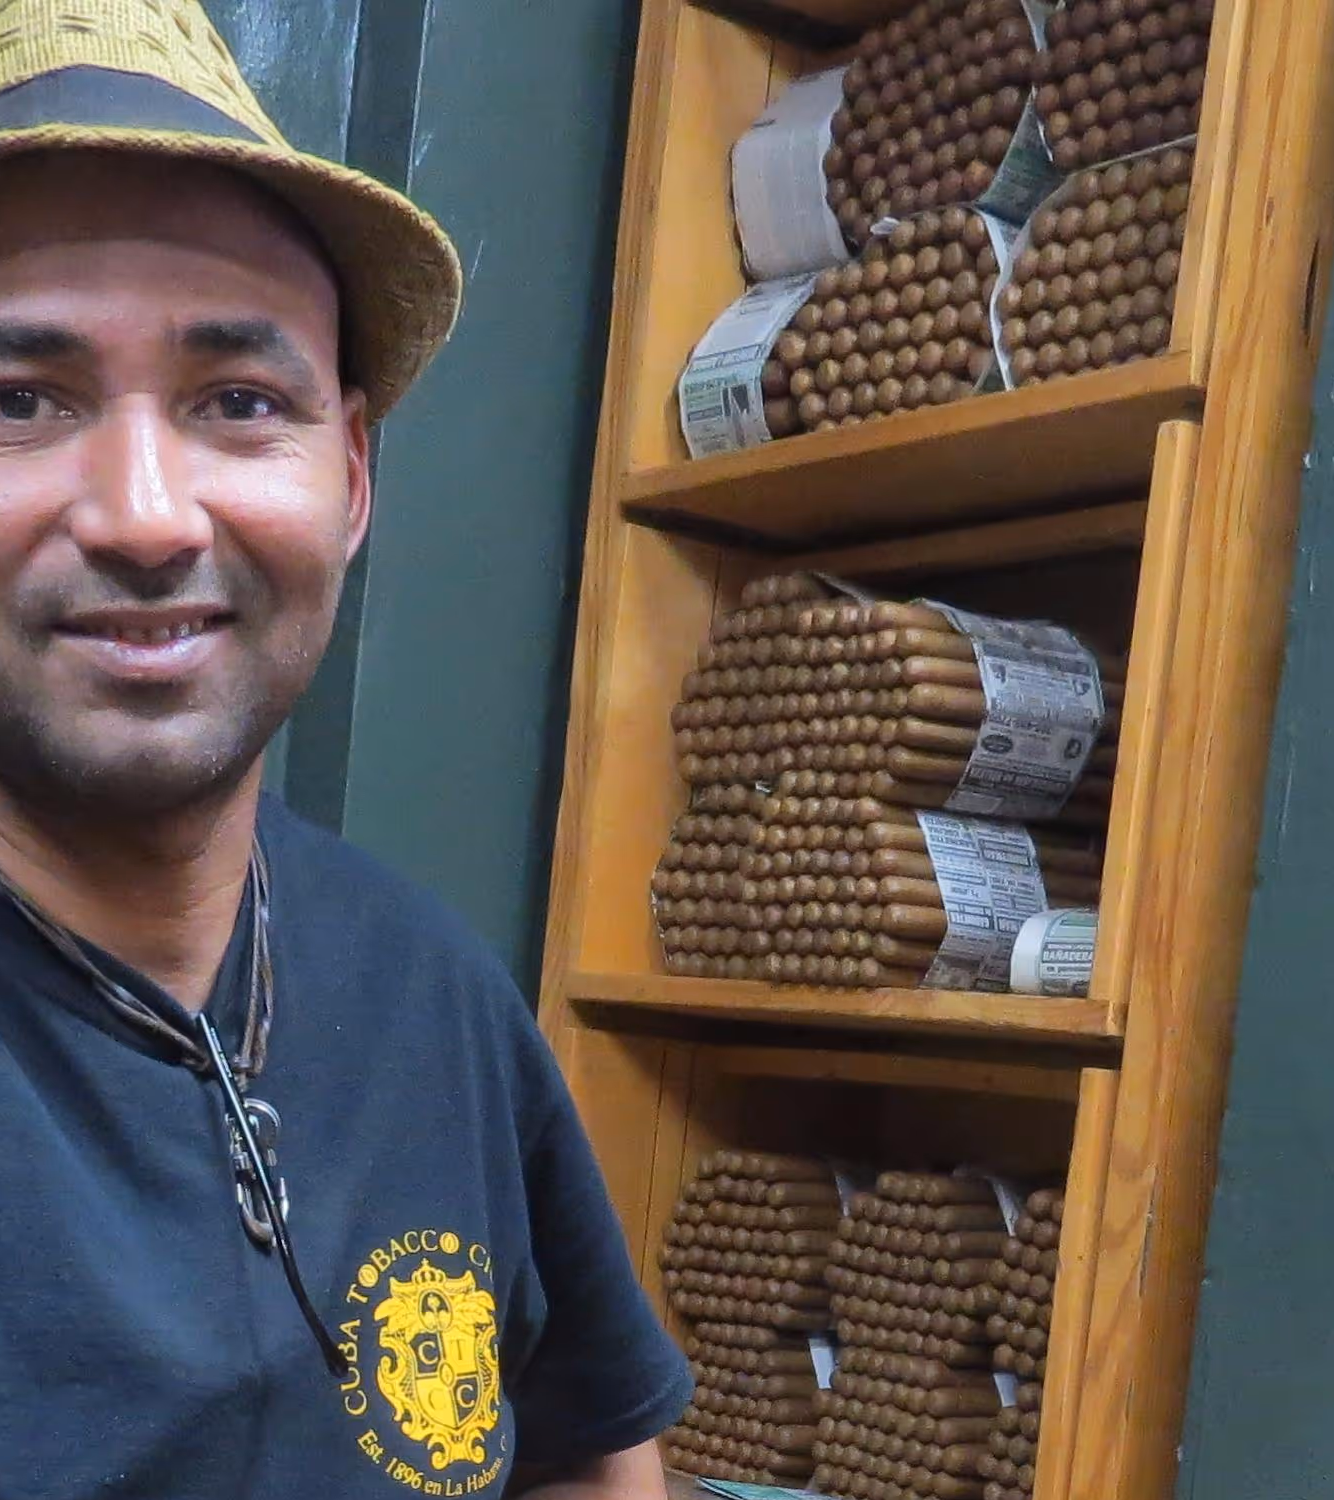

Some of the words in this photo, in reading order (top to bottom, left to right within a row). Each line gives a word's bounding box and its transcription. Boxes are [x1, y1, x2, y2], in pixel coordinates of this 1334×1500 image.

[346, 1229, 460, 1305] TOBACCO
[338, 1318, 368, 1416] CUBA
[357, 1429, 384, 1464] Est.
[385, 1457, 424, 1489] 1896
[424, 1480, 442, 1496] en
[445, 1478, 463, 1497] La
